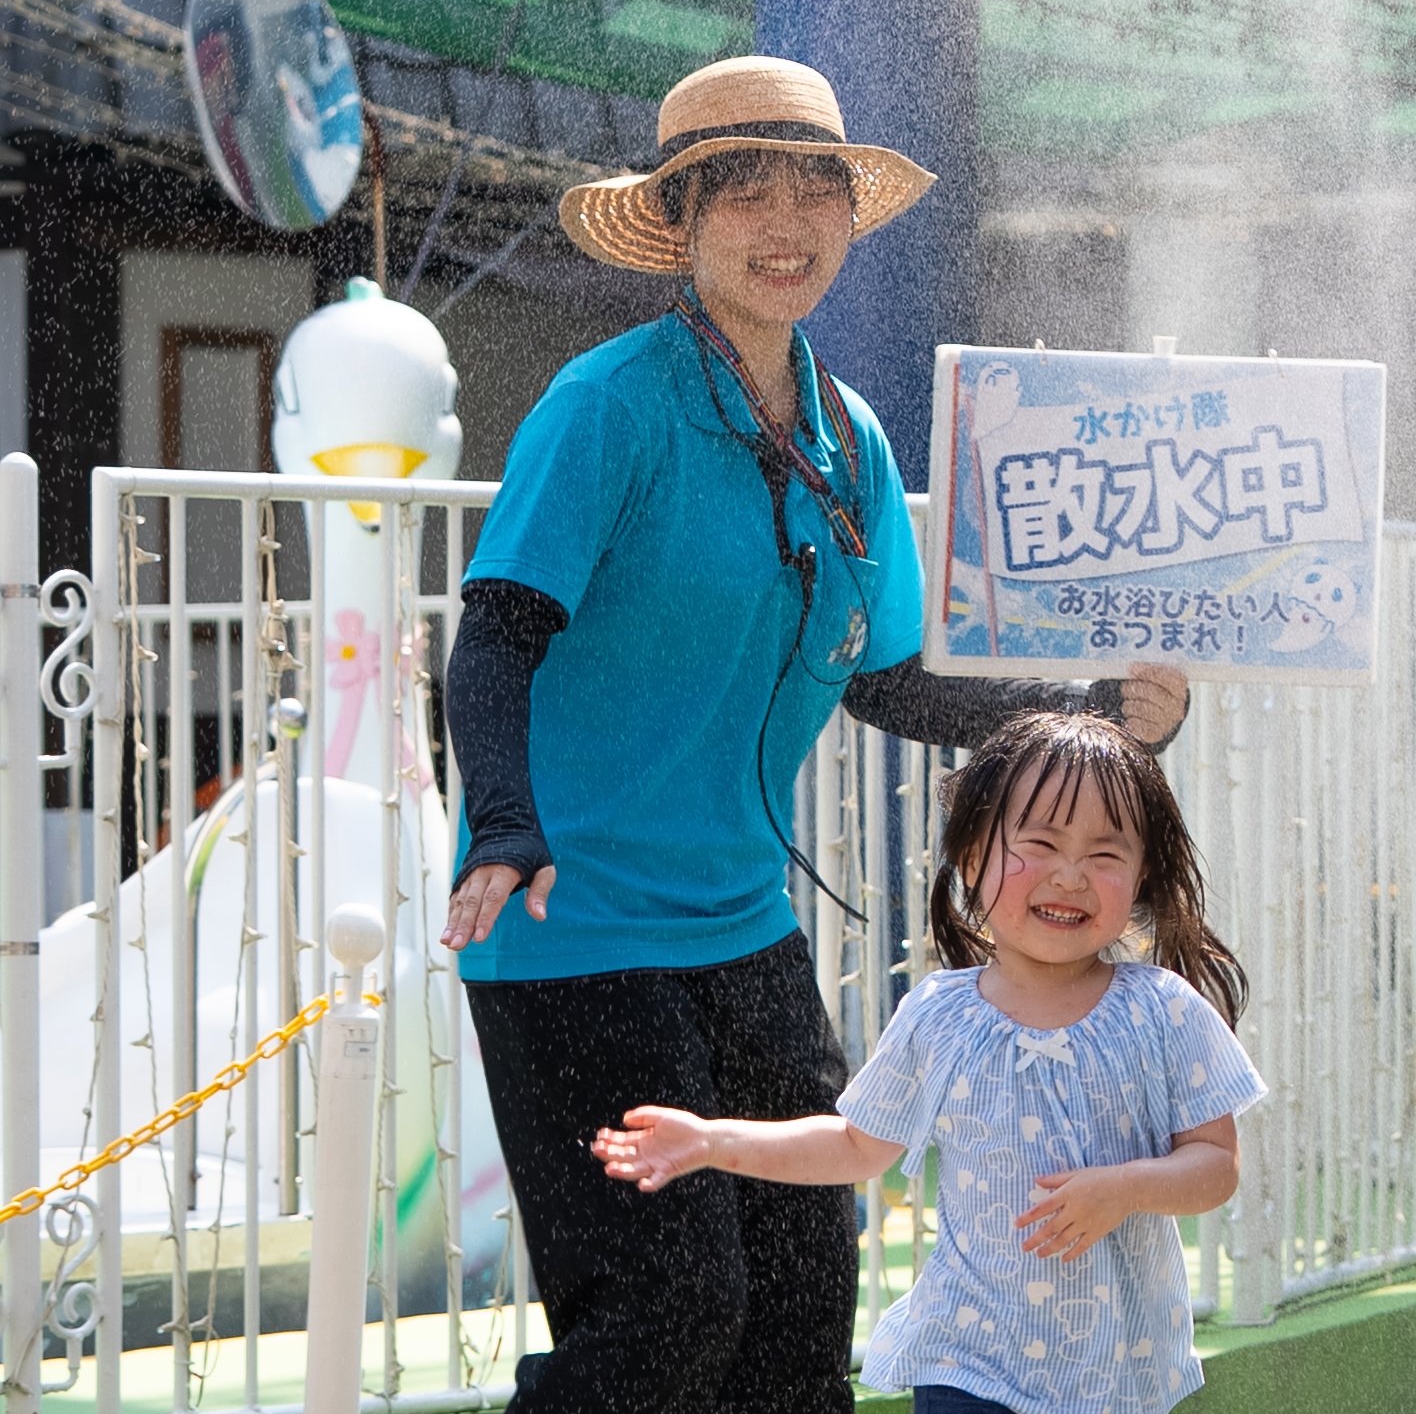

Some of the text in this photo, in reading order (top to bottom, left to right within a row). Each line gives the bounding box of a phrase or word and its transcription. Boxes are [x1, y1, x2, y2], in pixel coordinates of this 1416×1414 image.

[1073, 390, 1231, 445] 水かけ隊
[995, 425, 1328, 572] 散水中
[1057, 585, 1290, 623] お水浴びたい人
